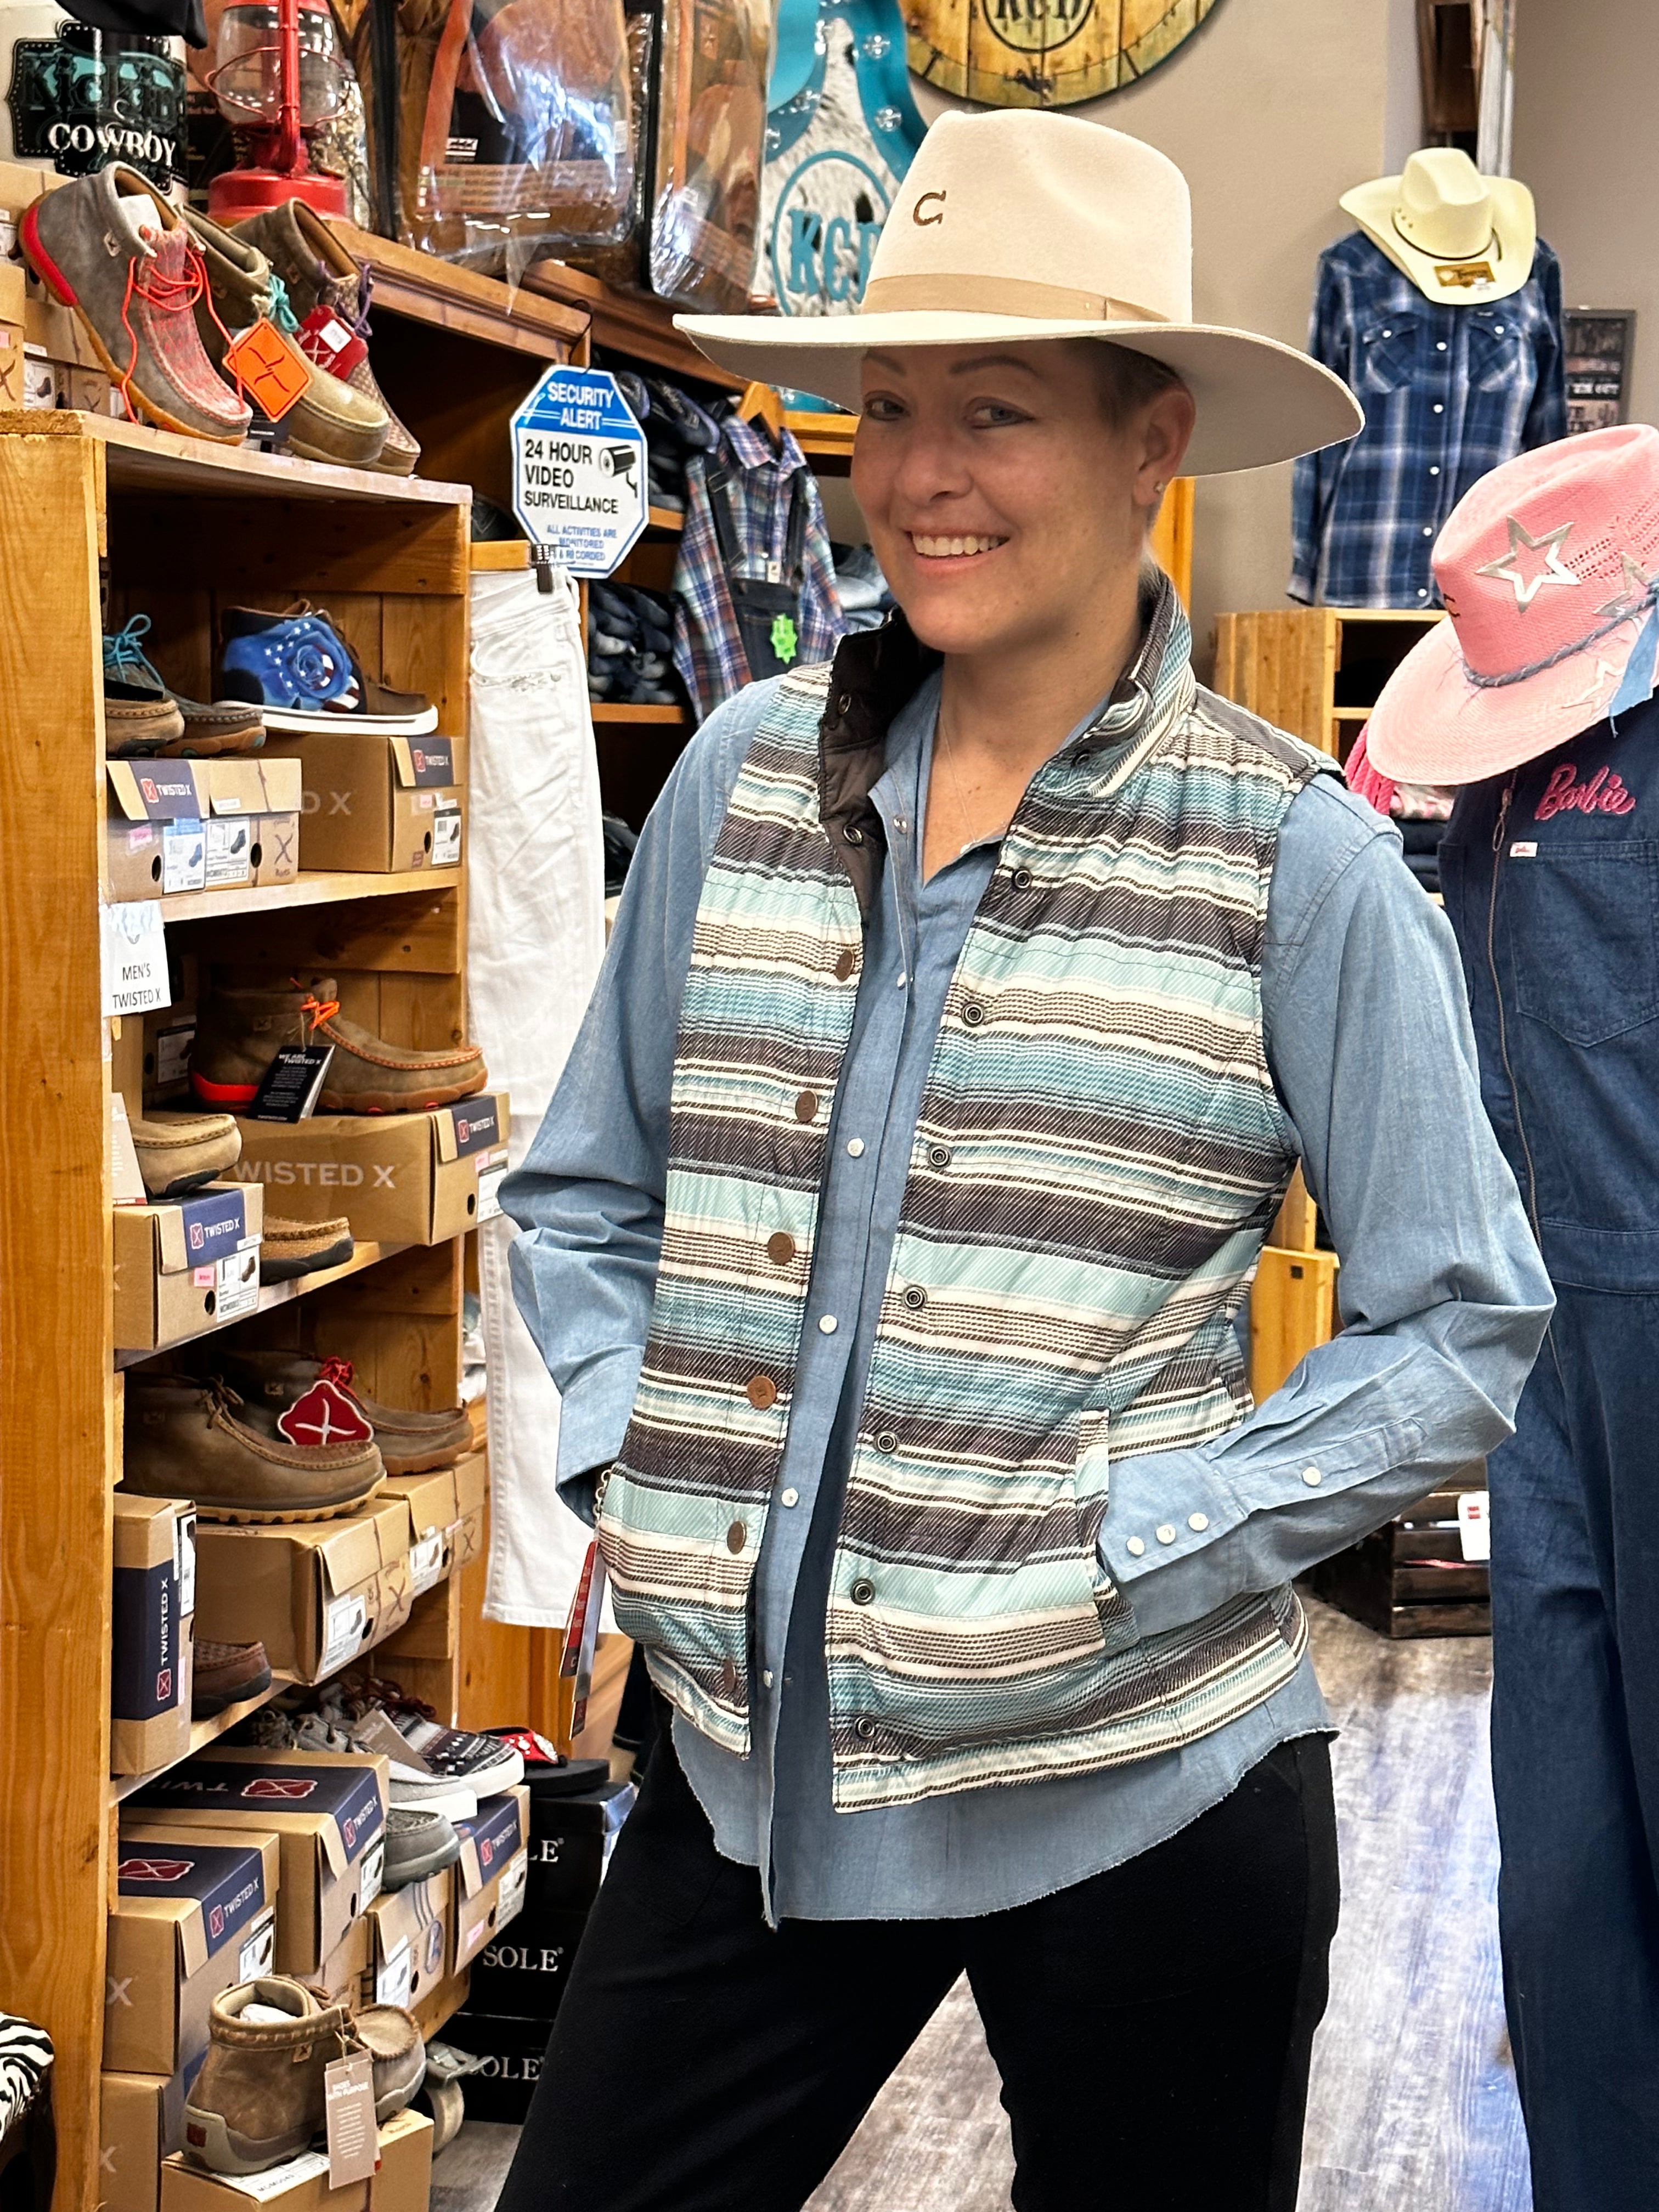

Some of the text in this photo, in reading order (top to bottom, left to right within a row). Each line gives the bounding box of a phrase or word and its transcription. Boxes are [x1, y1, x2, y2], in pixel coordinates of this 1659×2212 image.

[48, 122, 176, 166] COWBOY
[548, 382, 614, 408] SECURITY
[560, 408, 602, 430] ALERT
[525, 439, 592, 465] 24 HOUR
[525, 465, 574, 488] VIDEO
[524, 493, 619, 514] SURVEILLANCE
[547, 524, 617, 538] ALL ACTIVITIES ARE
[156, 785, 186, 796] TWISTED
[186, 785, 192, 795] X
[1534, 763, 1637, 821] Barbie
[122, 963, 151, 981] MEN'S
[112, 988, 161, 1009] TWISTED X
[234, 1161, 396, 1188] WISTED X
[204, 1219, 234, 1238] TWISTED
[234, 1217, 240, 1229] X
[161, 1577, 168, 1590] X
[354, 1800, 373, 1830] TWISTED
[224, 1883, 253, 1918] TWISTED
[253, 1877, 259, 1892] X
[483, 1945, 558, 1972] SOLE
[106, 1976, 133, 2006] X
[479, 2056, 540, 2080] OLE
